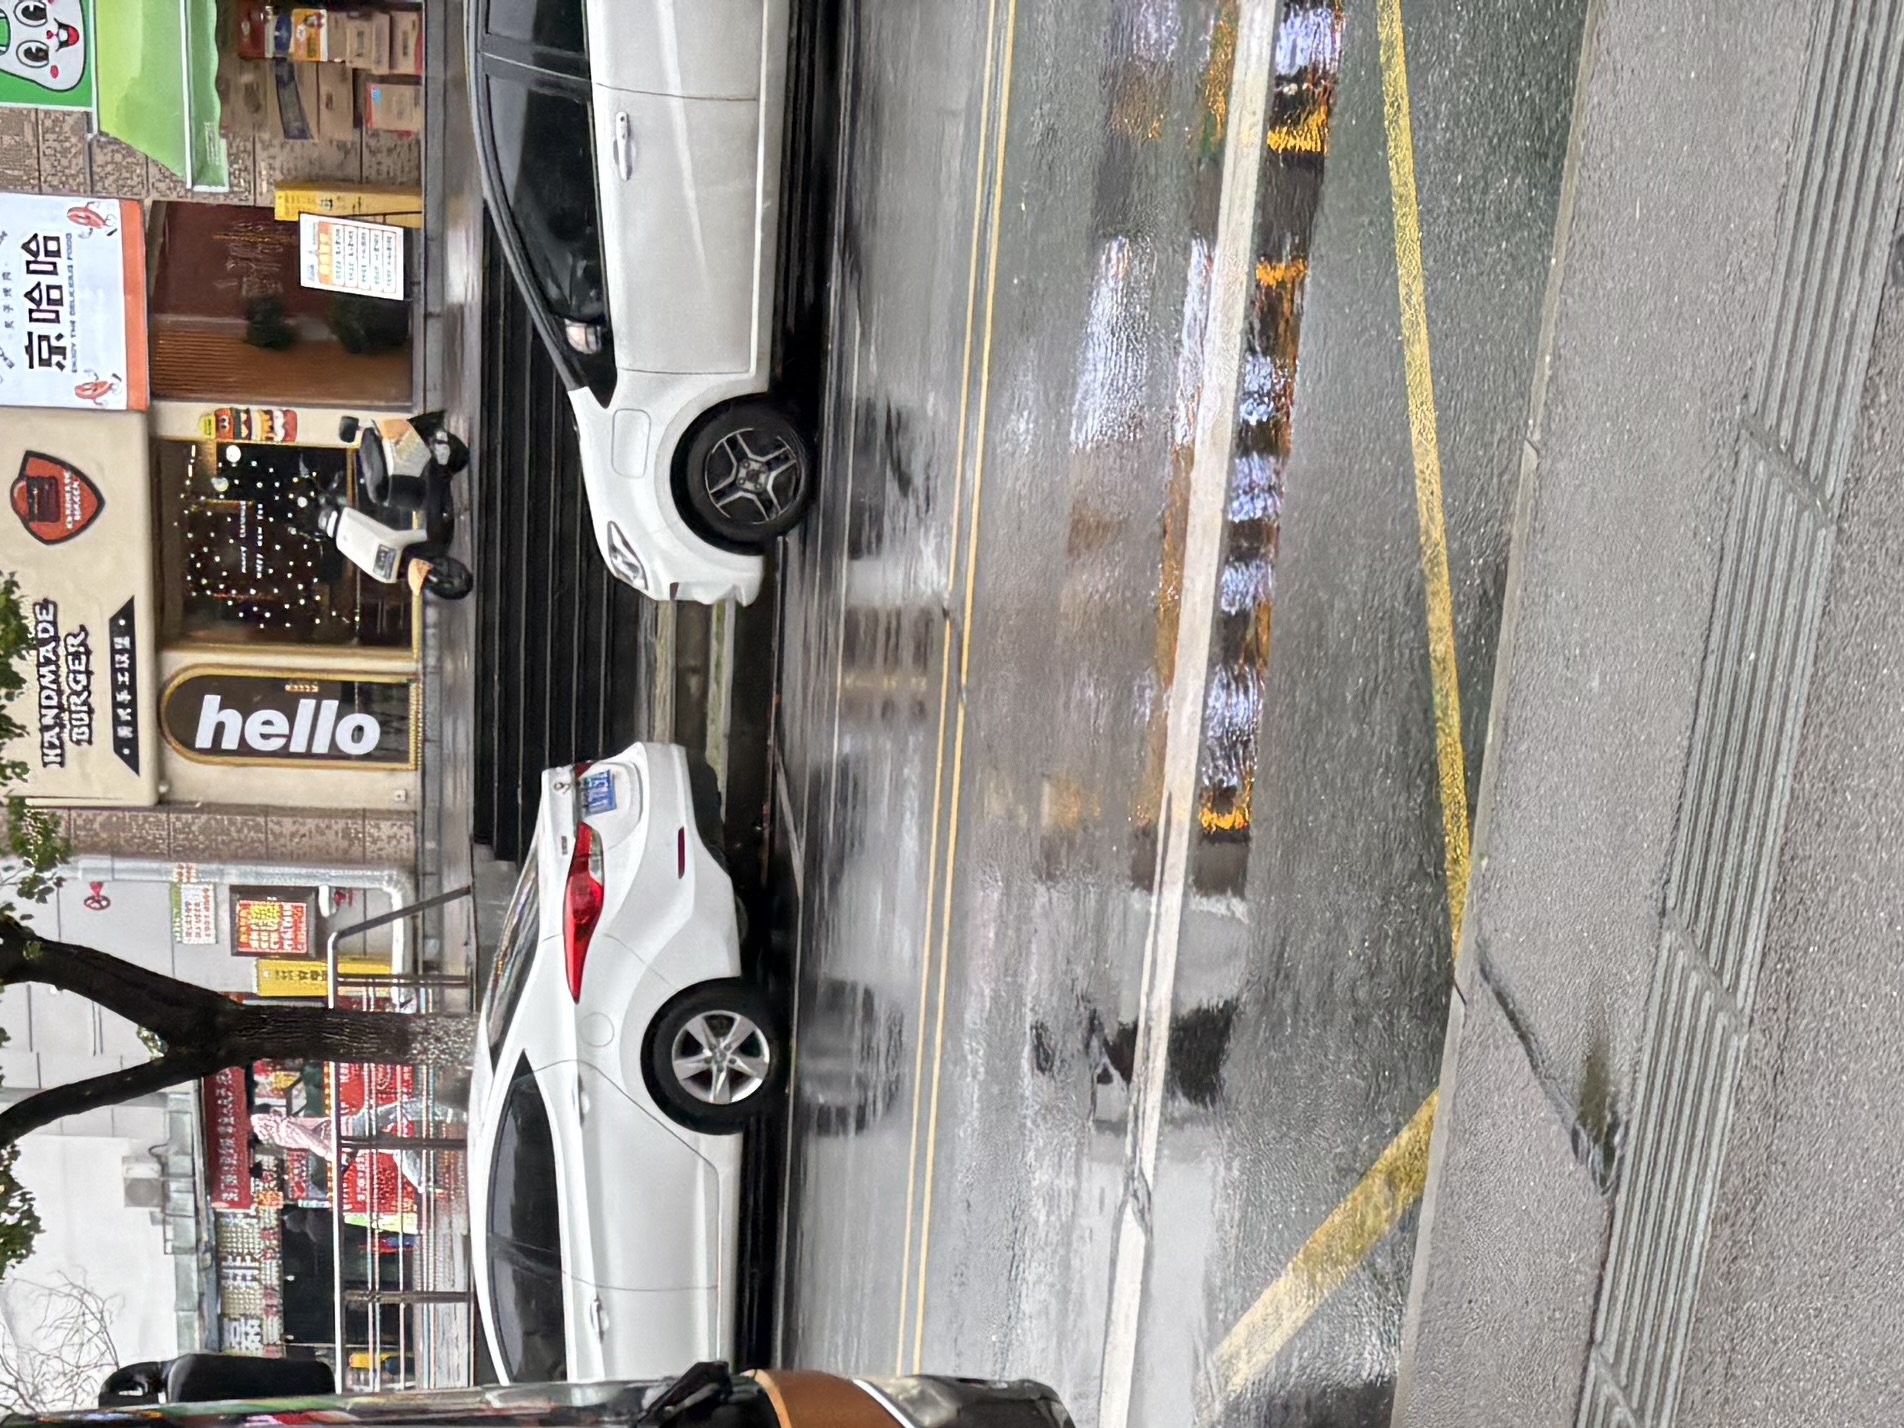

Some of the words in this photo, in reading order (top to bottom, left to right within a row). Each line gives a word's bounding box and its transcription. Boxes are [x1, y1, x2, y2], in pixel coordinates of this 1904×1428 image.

[21, 232, 67, 372] 京哈哈
[33, 599, 64, 766] HANDMADE
[63, 624, 92, 745] BURGER
[194, 694, 381, 755] hello
